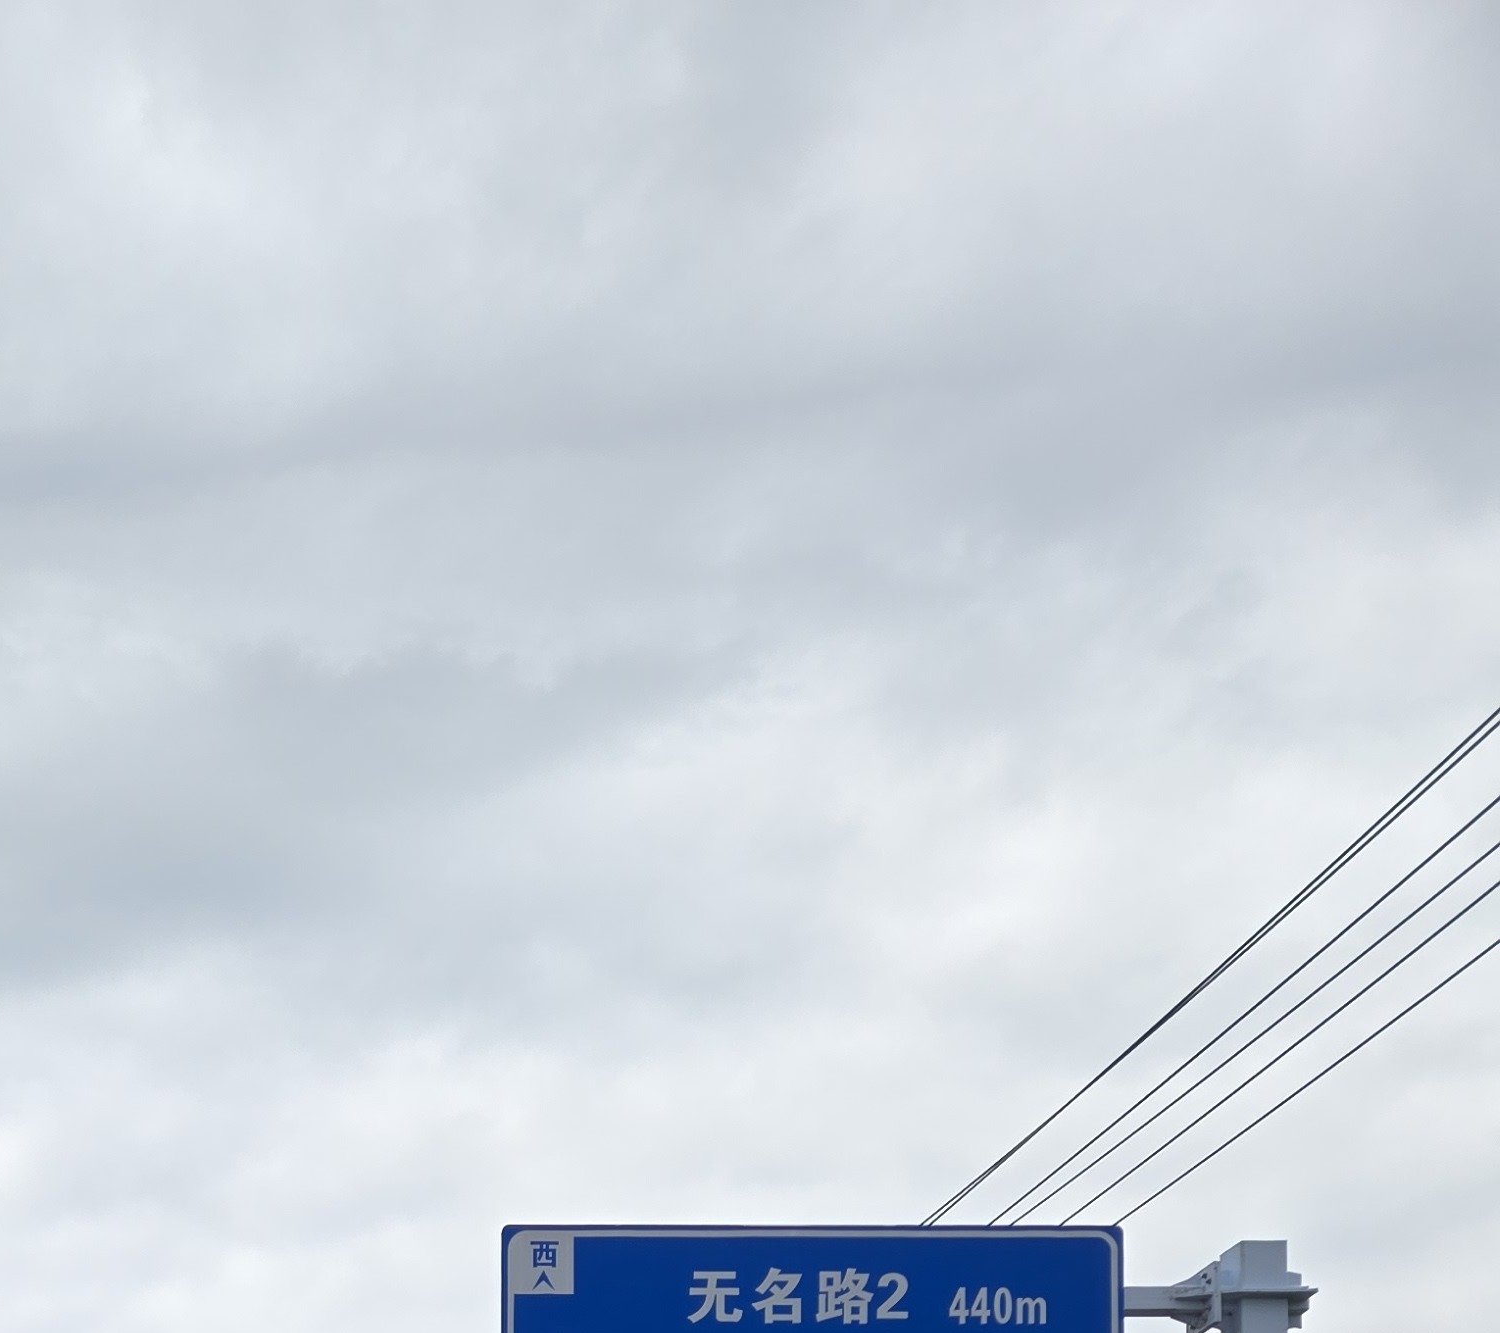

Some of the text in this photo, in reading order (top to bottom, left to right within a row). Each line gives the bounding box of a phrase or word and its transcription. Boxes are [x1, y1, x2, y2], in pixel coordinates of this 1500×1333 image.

[530, 1240, 560, 1268] 西
[687, 1267, 1047, 1325] 无名路2 440m
